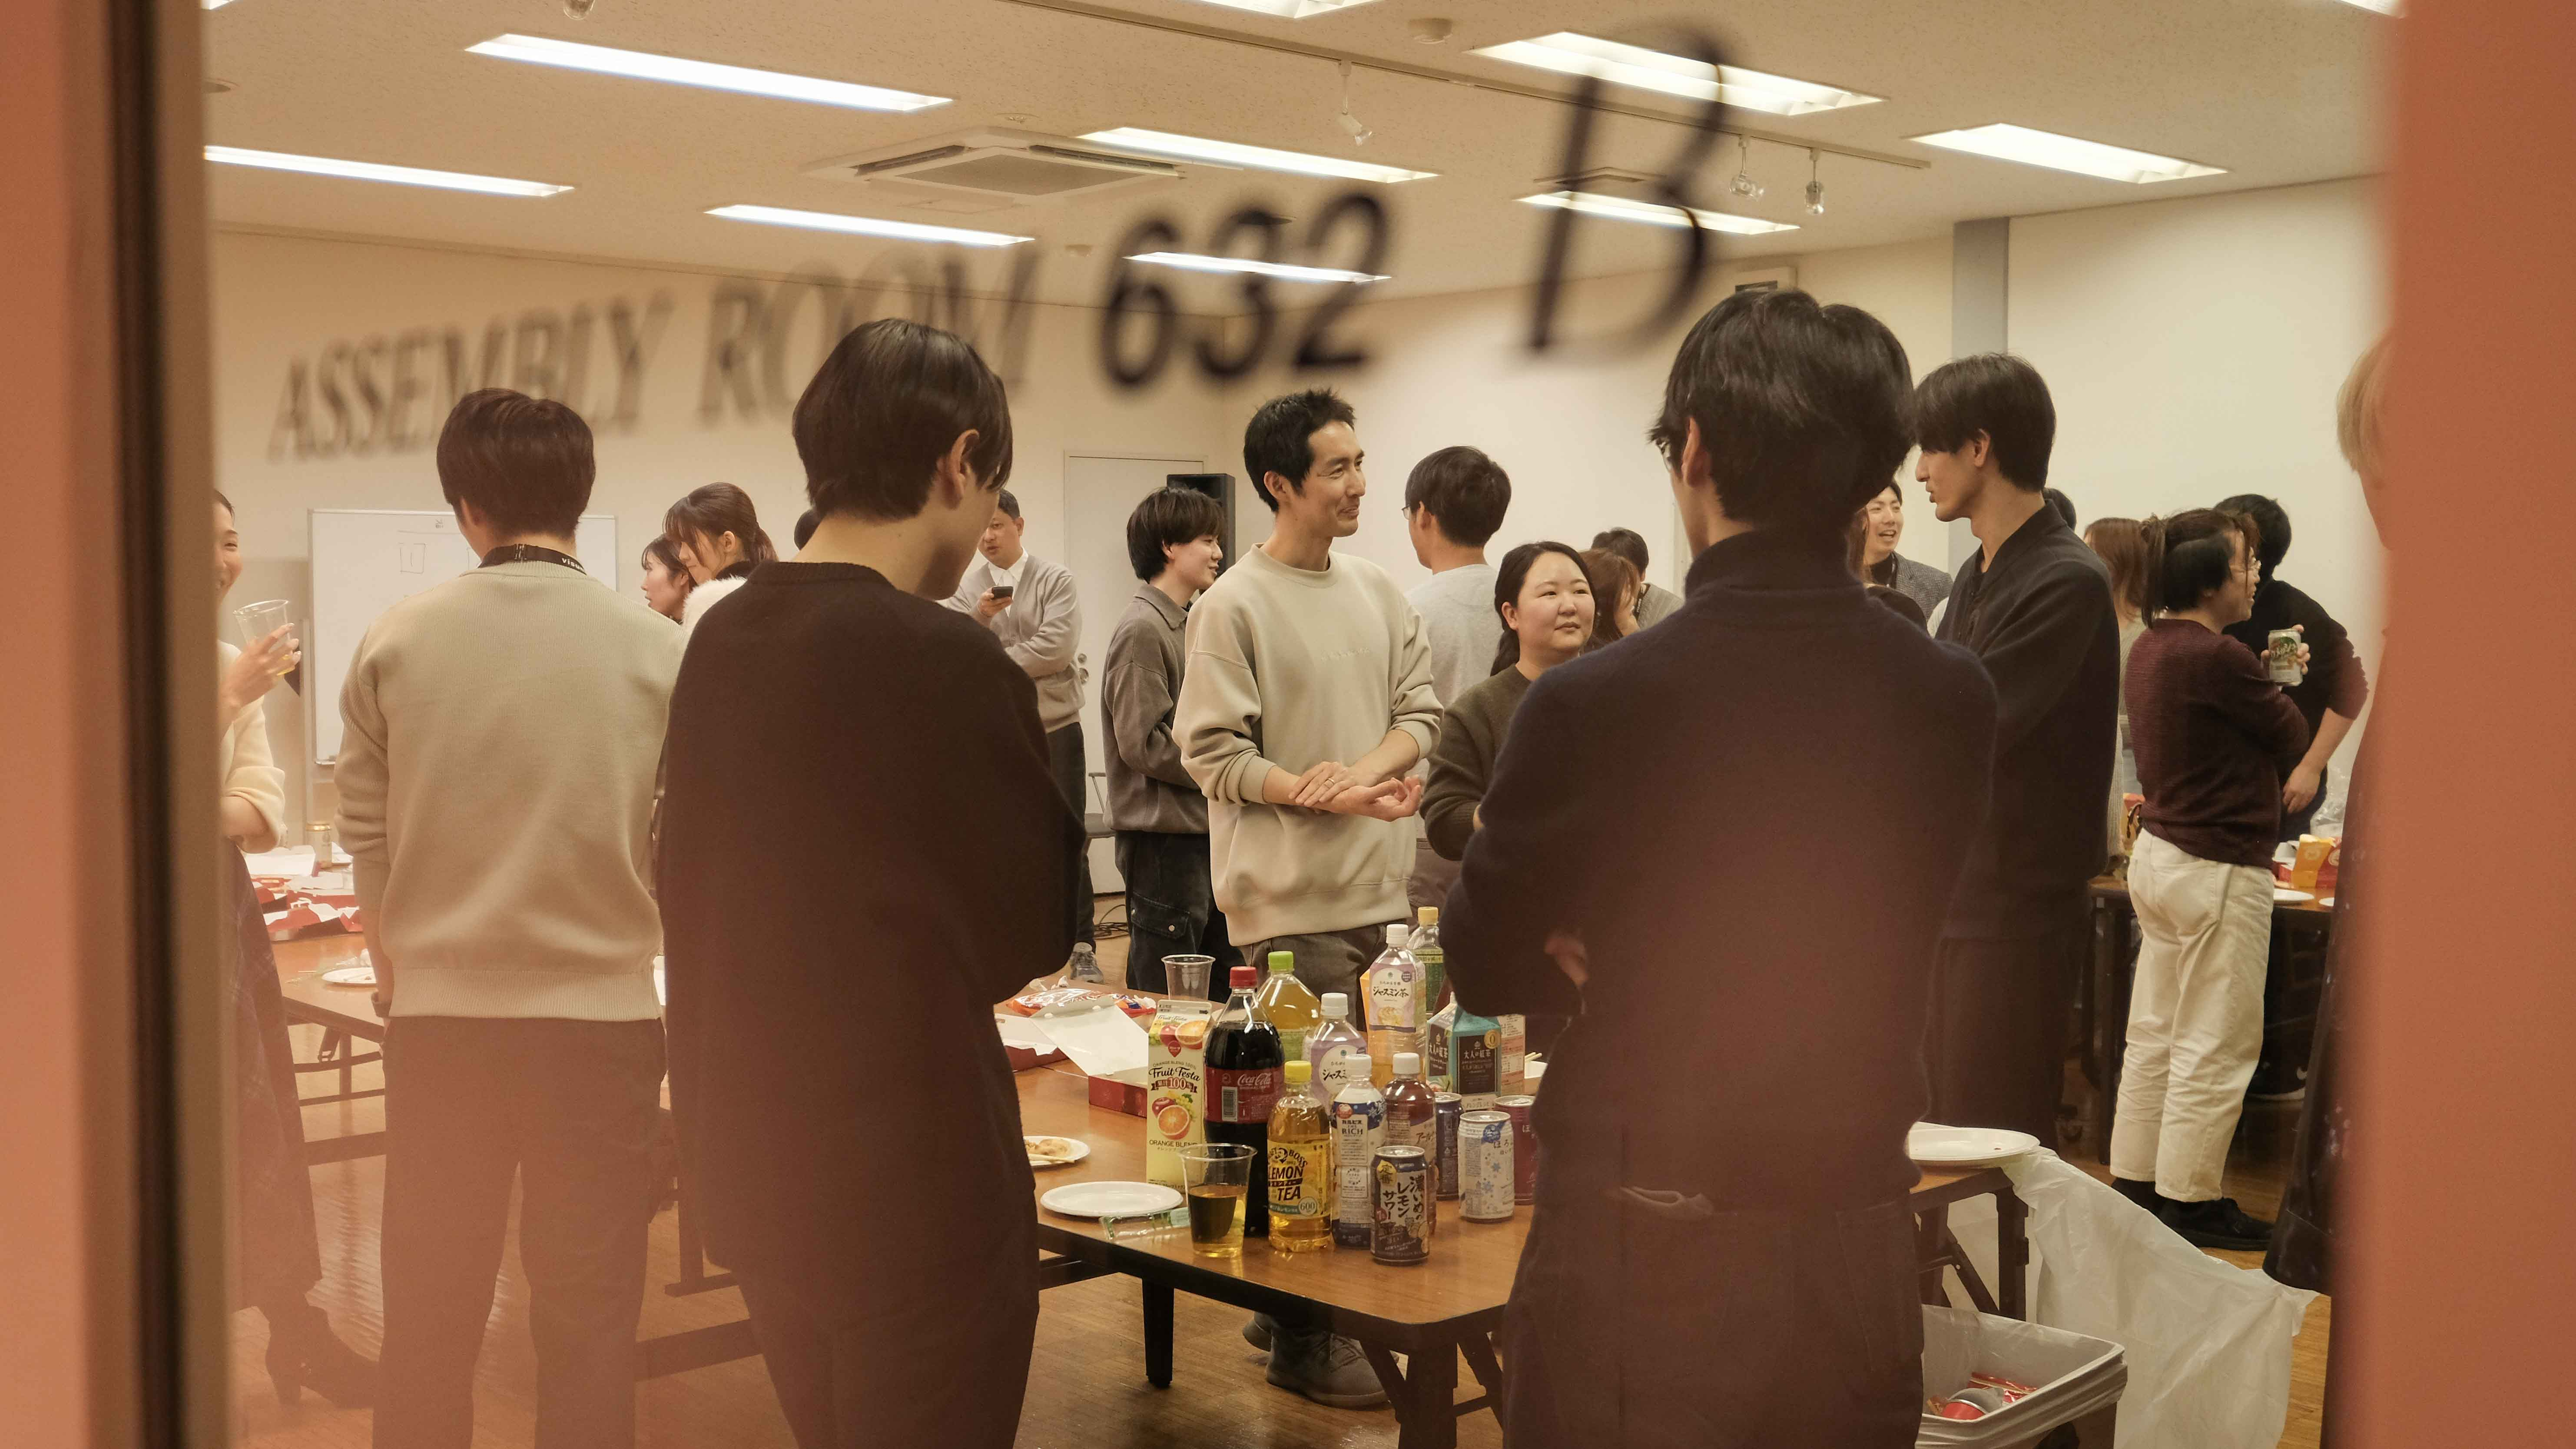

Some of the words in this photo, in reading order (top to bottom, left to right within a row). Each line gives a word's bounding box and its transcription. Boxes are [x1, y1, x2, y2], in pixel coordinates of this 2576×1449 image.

[271, 289, 674, 460] ASSEMBLY
[1097, 190, 1392, 391] 632
[1521, 18, 1743, 355] B
[1373, 987, 1409, 997] ジャスミン茶
[1148, 1067, 1175, 1078] Fruit
[1175, 1066, 1201, 1081] Testa
[1289, 1149, 1308, 1168] BOSS
[1268, 1166, 1304, 1180] LEMON
[1277, 1186, 1301, 1201] TEA
[1397, 1182, 1410, 1218] レモン
[1300, 1202, 1315, 1211] 600
[1383, 1190, 1397, 1220] サワー
